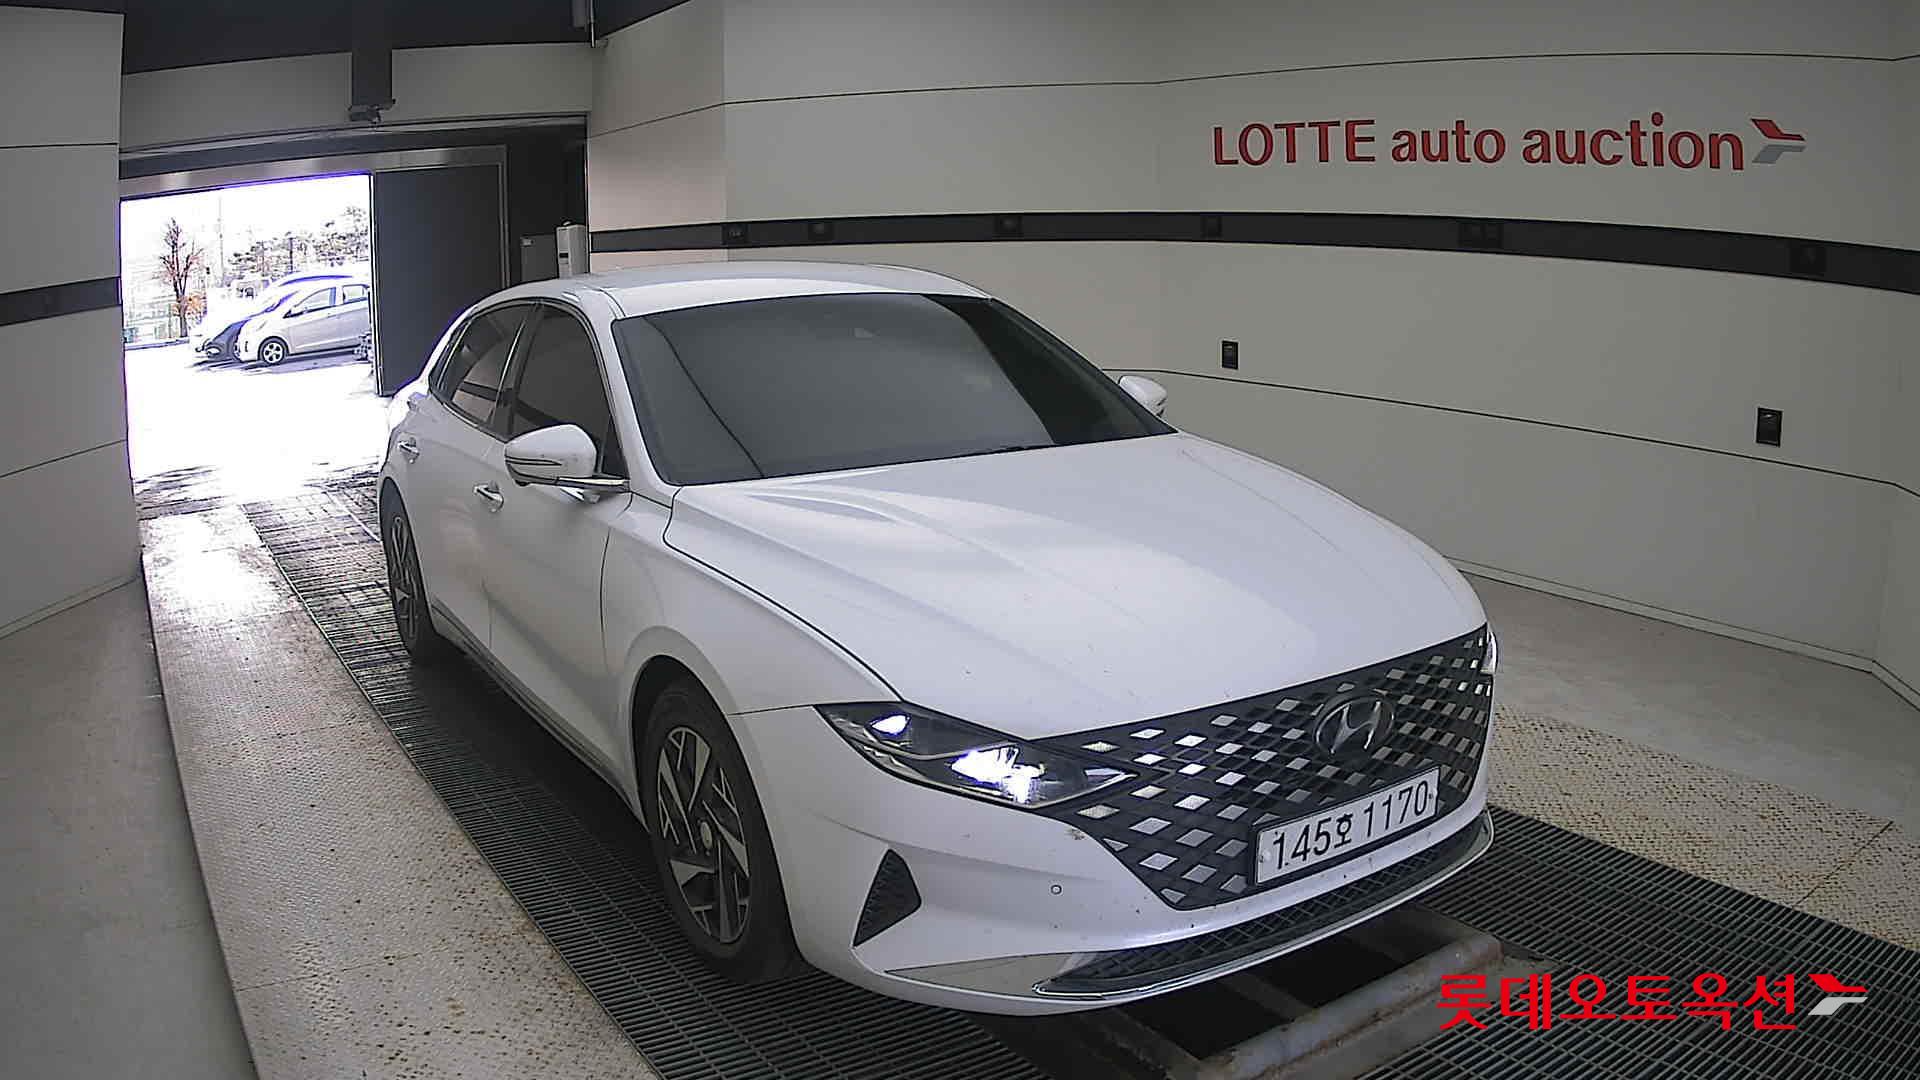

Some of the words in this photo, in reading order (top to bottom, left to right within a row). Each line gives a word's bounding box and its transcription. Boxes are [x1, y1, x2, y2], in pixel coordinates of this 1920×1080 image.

[1212, 119, 1376, 166] LOTTE
[1391, 119, 1506, 164] auto
[1521, 111, 1745, 171] auction
[1272, 813, 1354, 870] 145호
[1363, 780, 1429, 838] 1170
